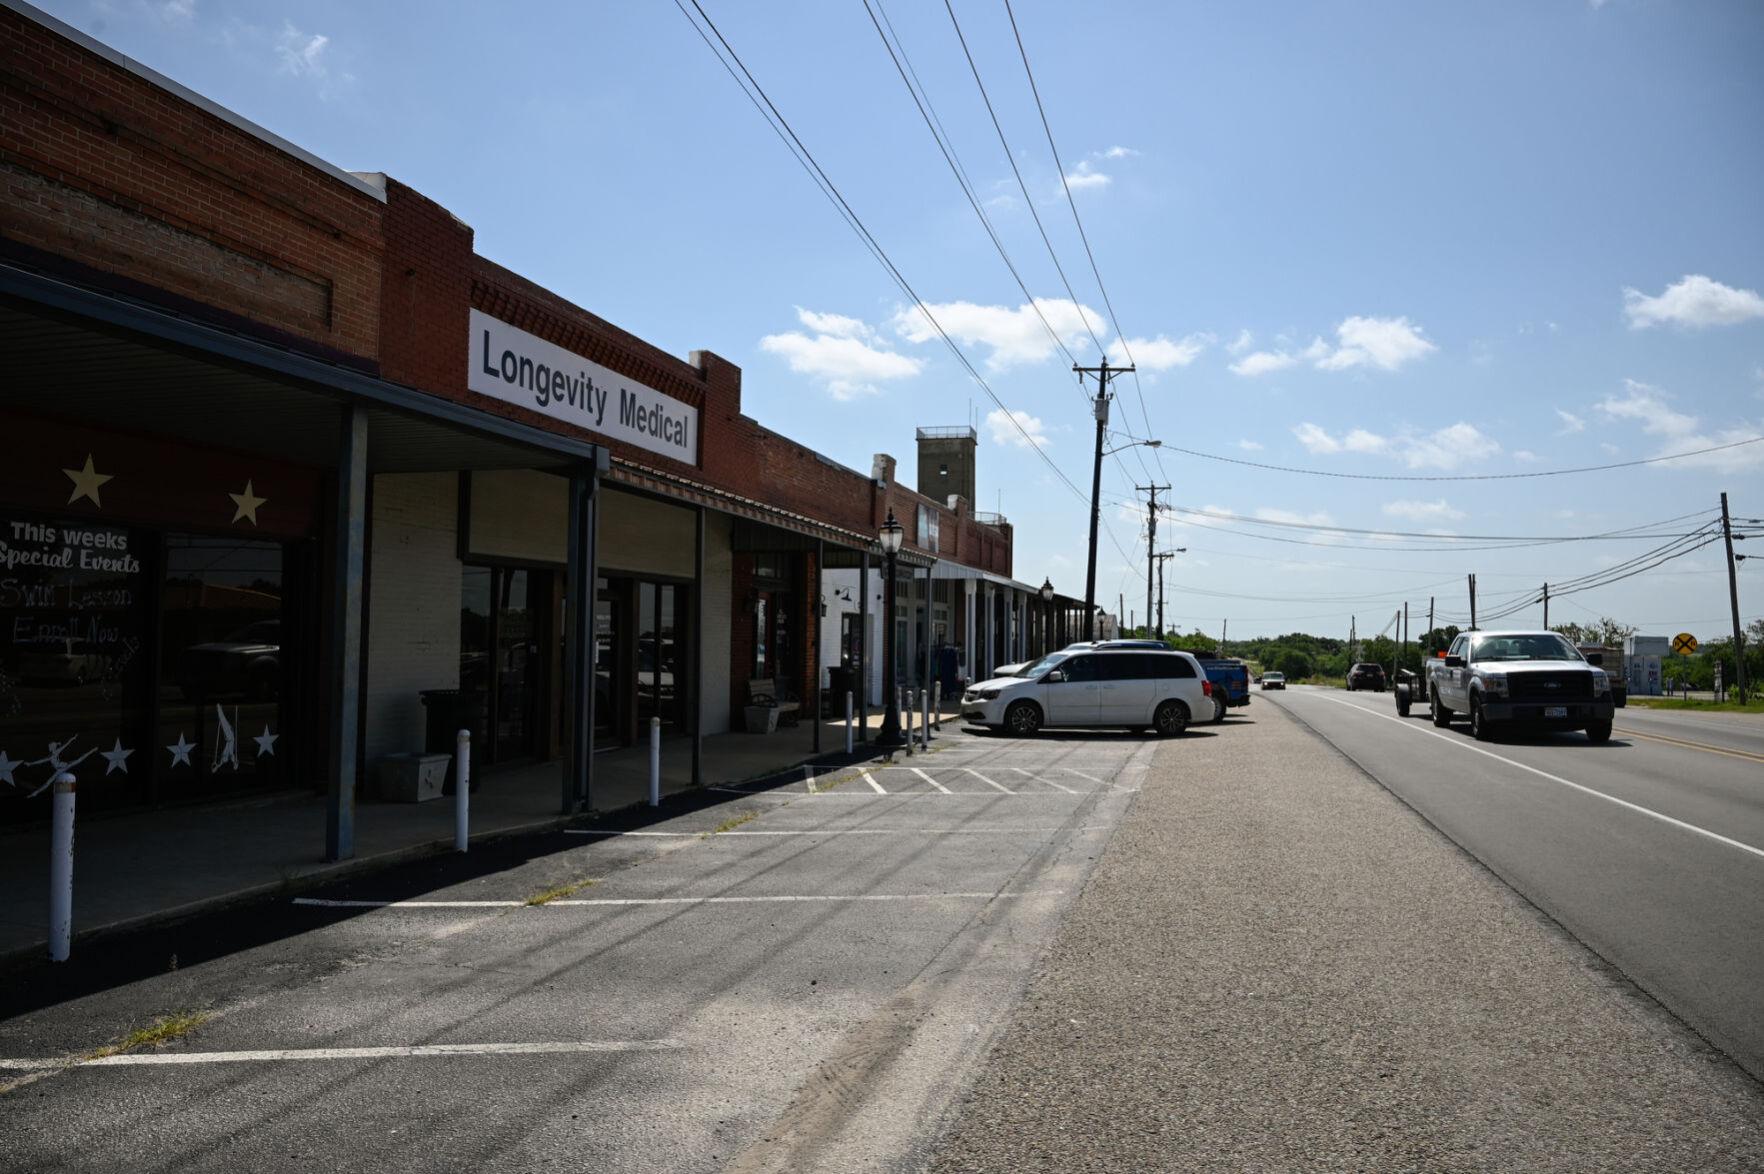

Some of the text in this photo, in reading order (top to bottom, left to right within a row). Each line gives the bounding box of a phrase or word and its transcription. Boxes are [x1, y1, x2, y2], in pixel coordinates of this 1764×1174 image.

[483, 330, 688, 448] Longevity Medical
[10, 521, 128, 550] This weeks
[0, 541, 140, 573] Special Events
